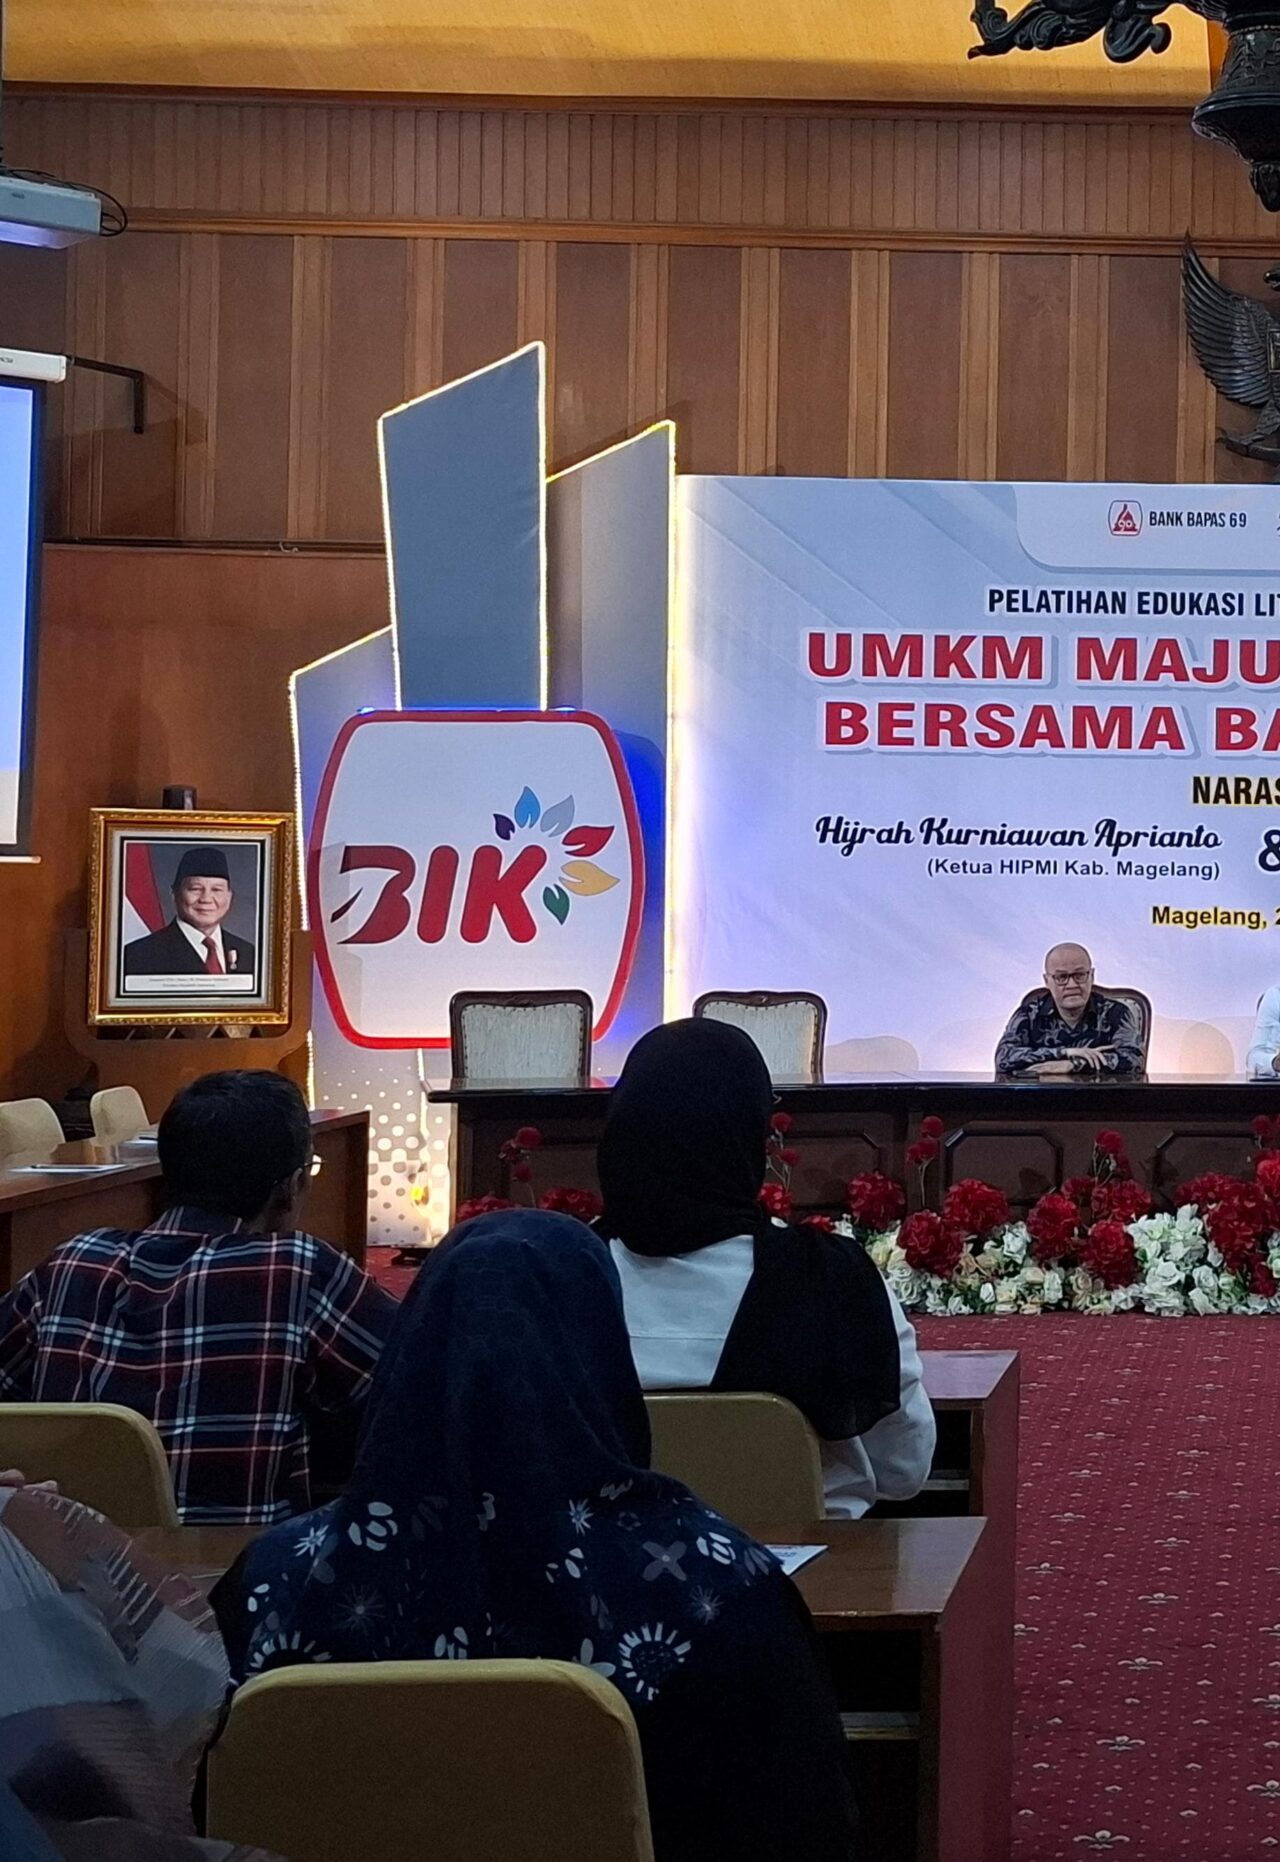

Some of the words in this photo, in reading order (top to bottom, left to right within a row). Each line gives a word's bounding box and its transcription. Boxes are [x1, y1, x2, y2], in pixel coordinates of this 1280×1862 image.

[1149, 511, 1183, 526] BANK
[1187, 512, 1225, 527] BAPAS
[1229, 513, 1247, 527] 69
[988, 589, 1126, 614] PELATIHAN
[1137, 591, 1244, 616] EDUKASI
[808, 632, 1043, 680] UMKM
[824, 701, 1185, 750] BERSAMA
[815, 815, 914, 857] Hijrah
[919, 817, 1088, 847] Kurniawan
[1094, 818, 1222, 856] Aprianto
[928, 858, 993, 877] (Ketua
[1000, 859, 1058, 875] HIPMI
[1065, 860, 1109, 876] Kab.
[1117, 861, 1220, 880] Magelang)
[331, 844, 547, 944] BIK
[1152, 906, 1267, 929] Magelang,
